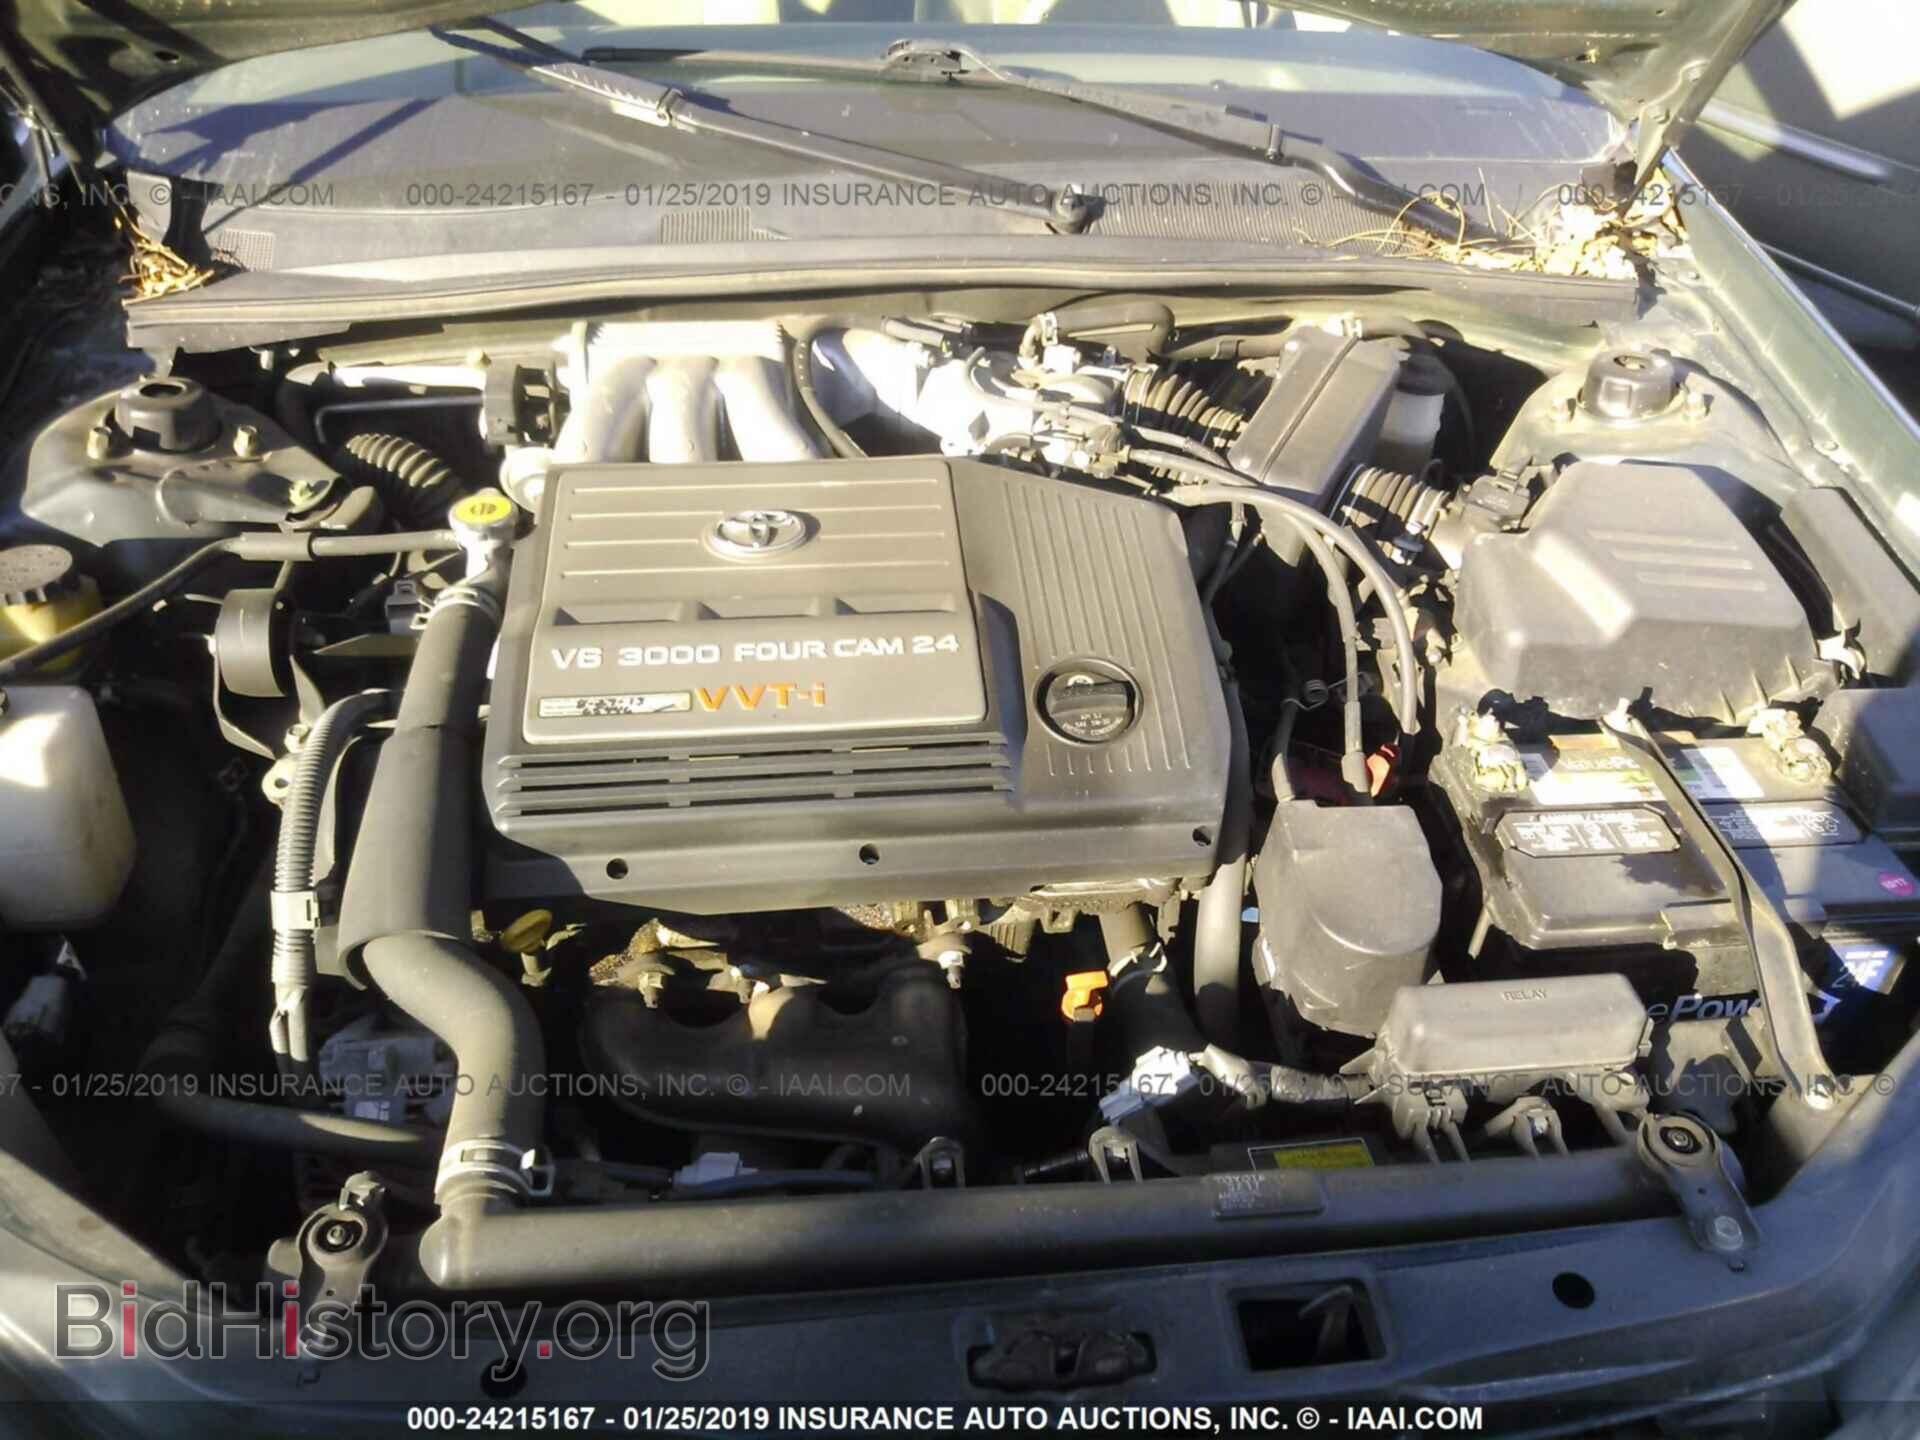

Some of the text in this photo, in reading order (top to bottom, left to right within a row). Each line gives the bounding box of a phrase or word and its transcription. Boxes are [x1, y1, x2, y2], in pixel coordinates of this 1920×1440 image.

[551, 633, 959, 670] V6 3000 FOUR CAM 24
[695, 682, 826, 712] VVT-i
[1501, 987, 1547, 1001] RELAY
[1648, 996, 1762, 1022] ePow
